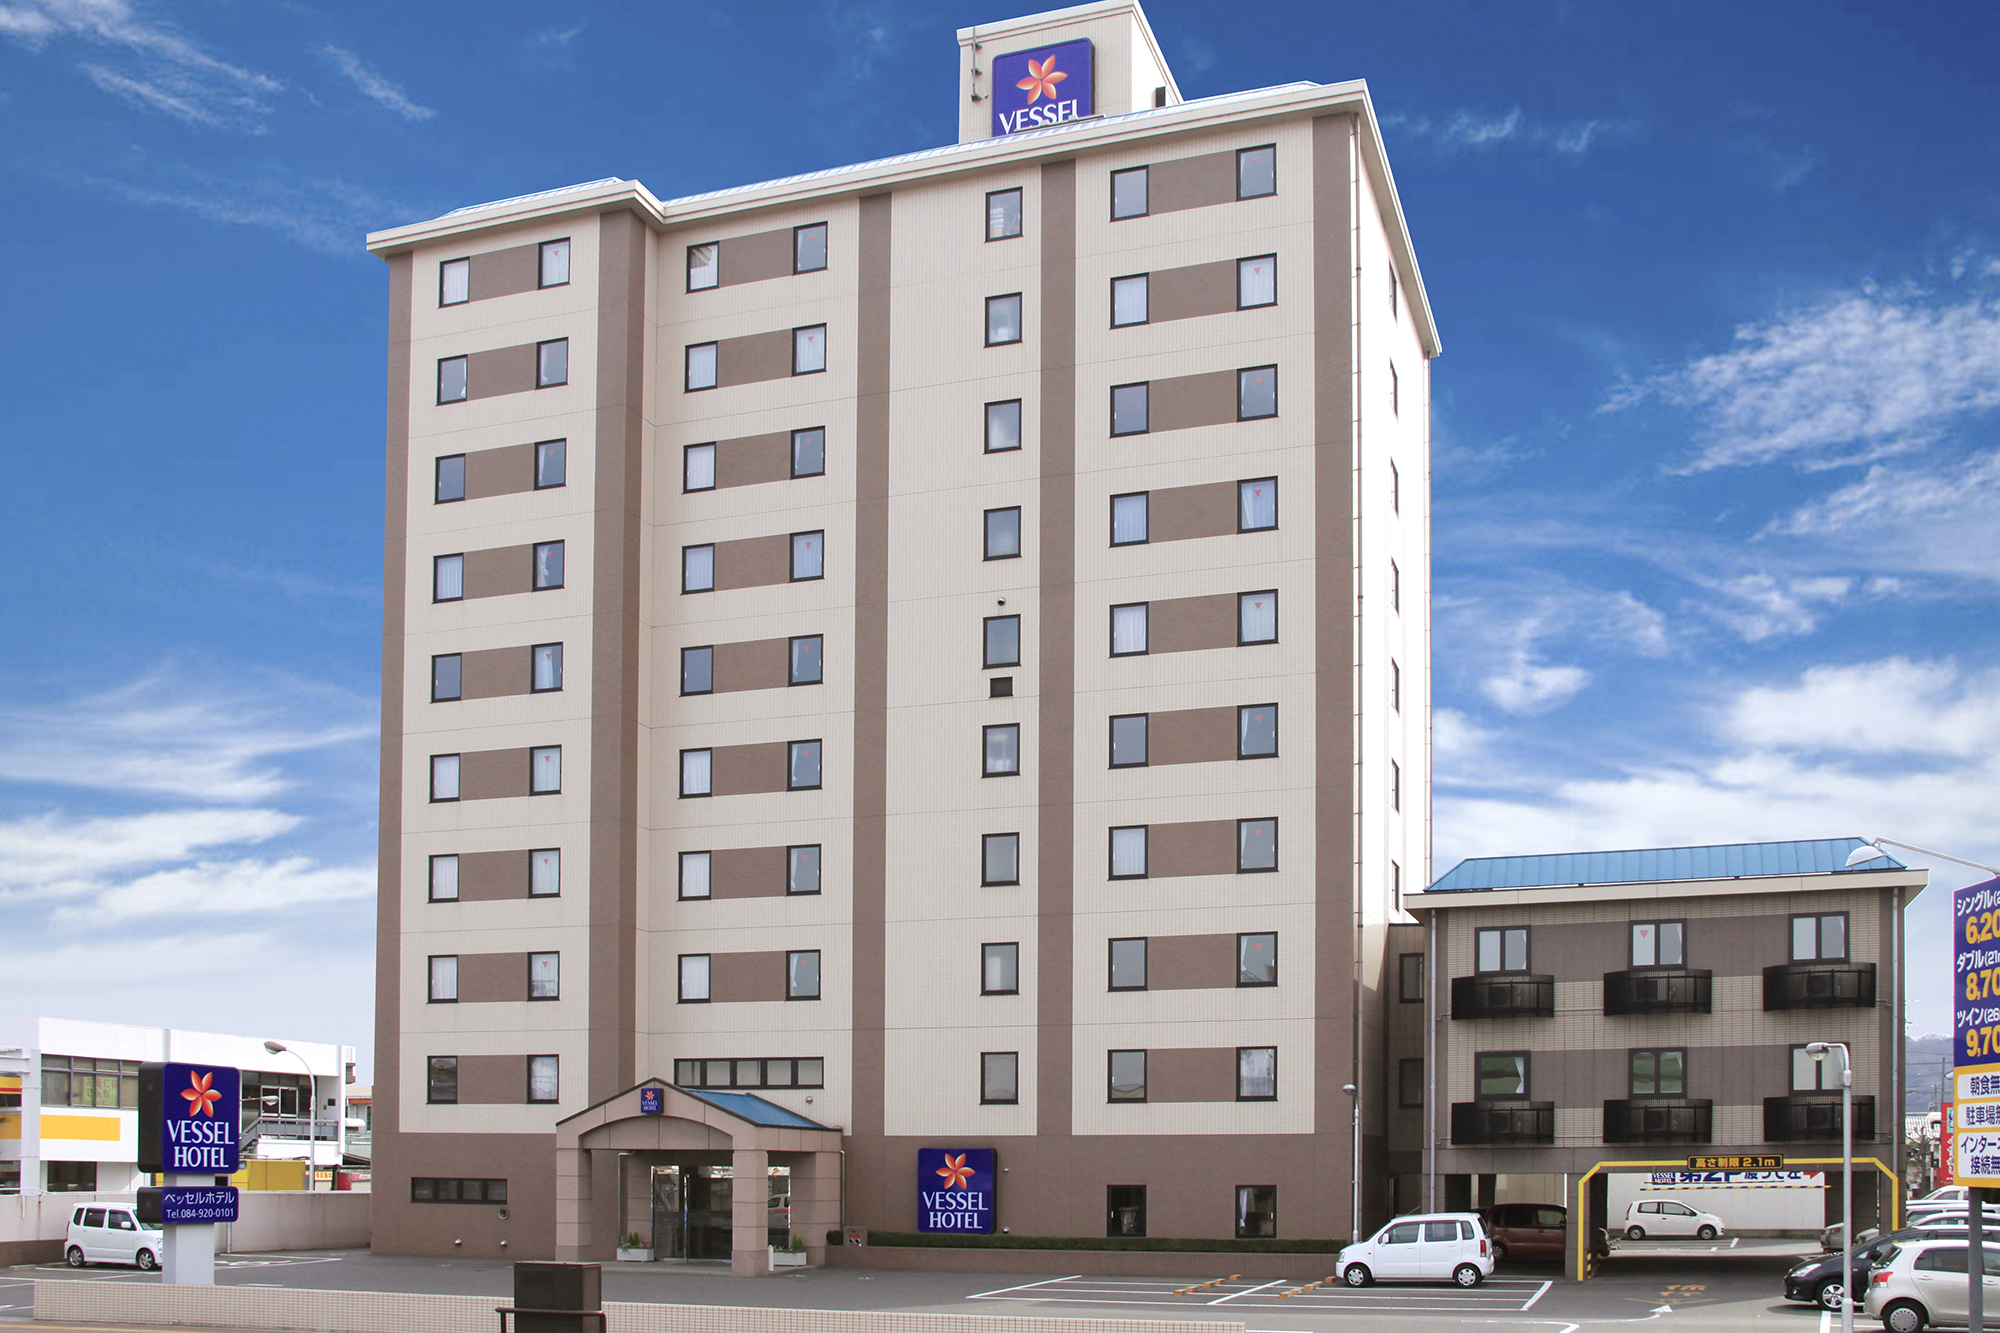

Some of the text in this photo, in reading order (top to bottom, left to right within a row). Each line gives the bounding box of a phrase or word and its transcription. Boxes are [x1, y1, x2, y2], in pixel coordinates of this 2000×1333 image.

[999, 99, 1078, 134] VESSEL
[1957, 949, 2000, 973] ダブル(21
[1957, 1007, 2000, 1028] ツイン(26
[1970, 1075, 2000, 1096] 朝食無
[166, 1119, 235, 1145] VESSEL
[173, 1146, 229, 1168] HOTEL
[1695, 1157, 1776, 1168] 高さ制限 2.1m
[1971, 1155, 2000, 1175] 接続無
[164, 1191, 235, 1205] ベッセルホテル
[922, 1191, 989, 1210] VESSEL
[166, 1207, 234, 1219] Tel.084-920-0101
[929, 1211, 983, 1229] HOTEL
